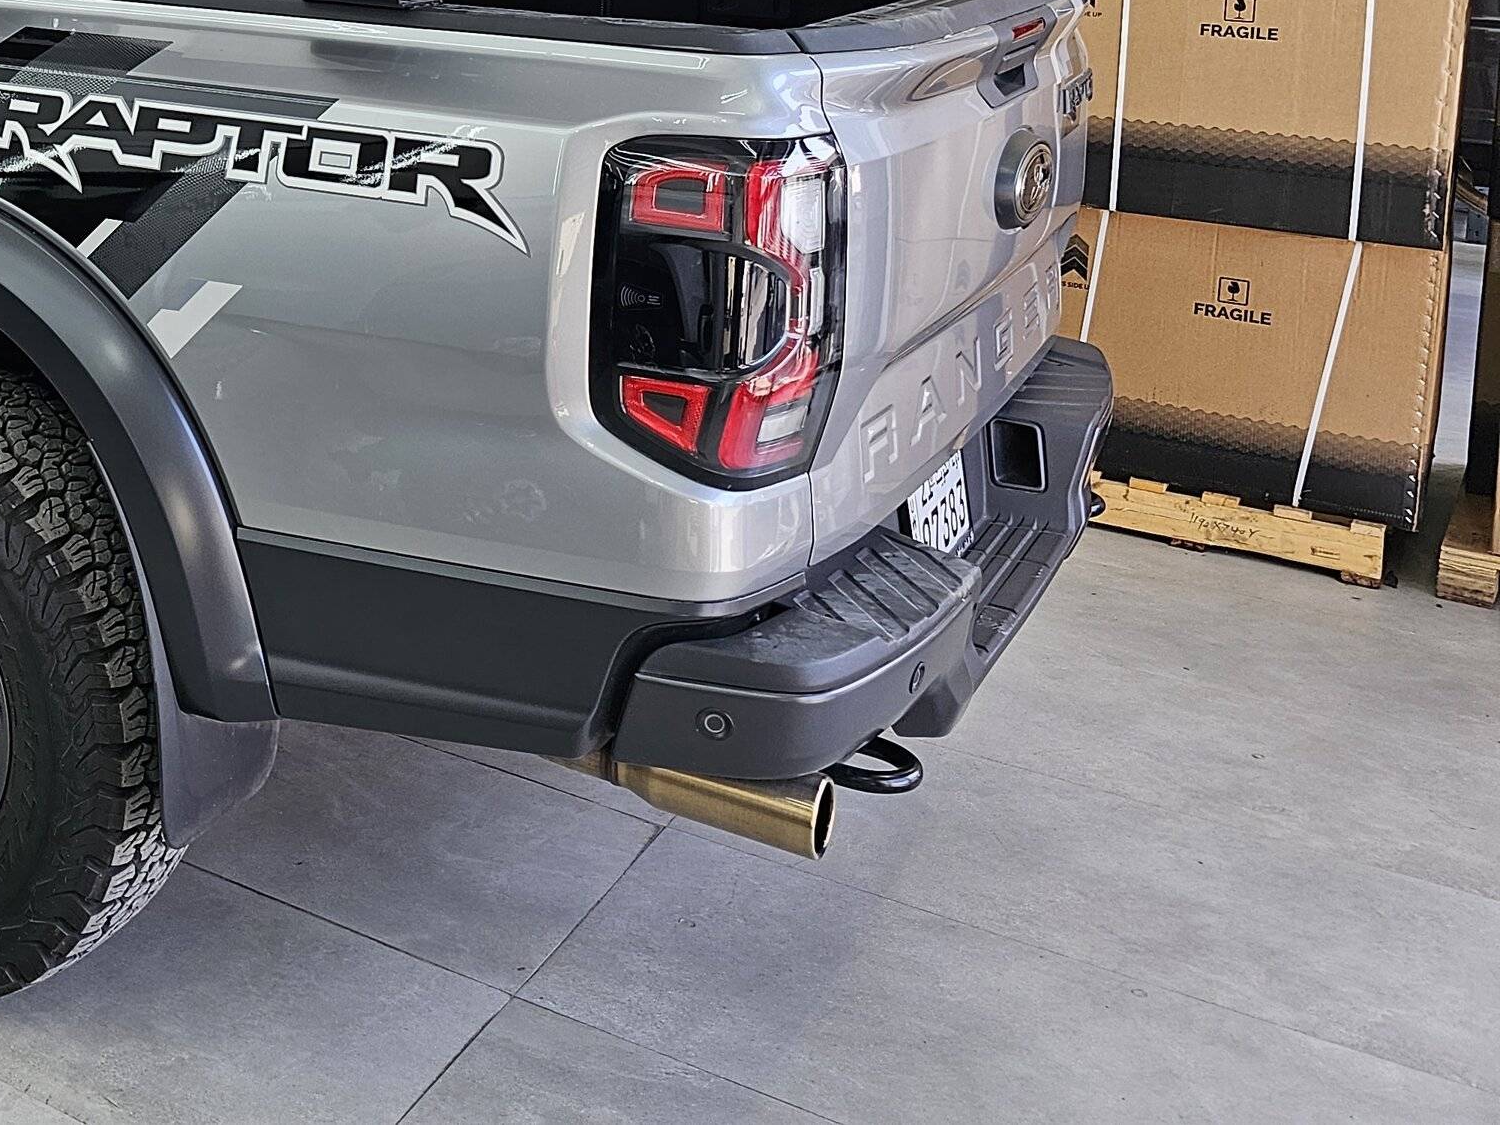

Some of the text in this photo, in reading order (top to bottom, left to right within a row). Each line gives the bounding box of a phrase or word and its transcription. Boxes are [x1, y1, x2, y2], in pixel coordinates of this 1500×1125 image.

[1199, 22, 1280, 42] FRAGILE
[1067, 281, 1084, 290] SIDE
[1193, 301, 1273, 325] FRAGILE
[859, 261, 1061, 484] RANGER
